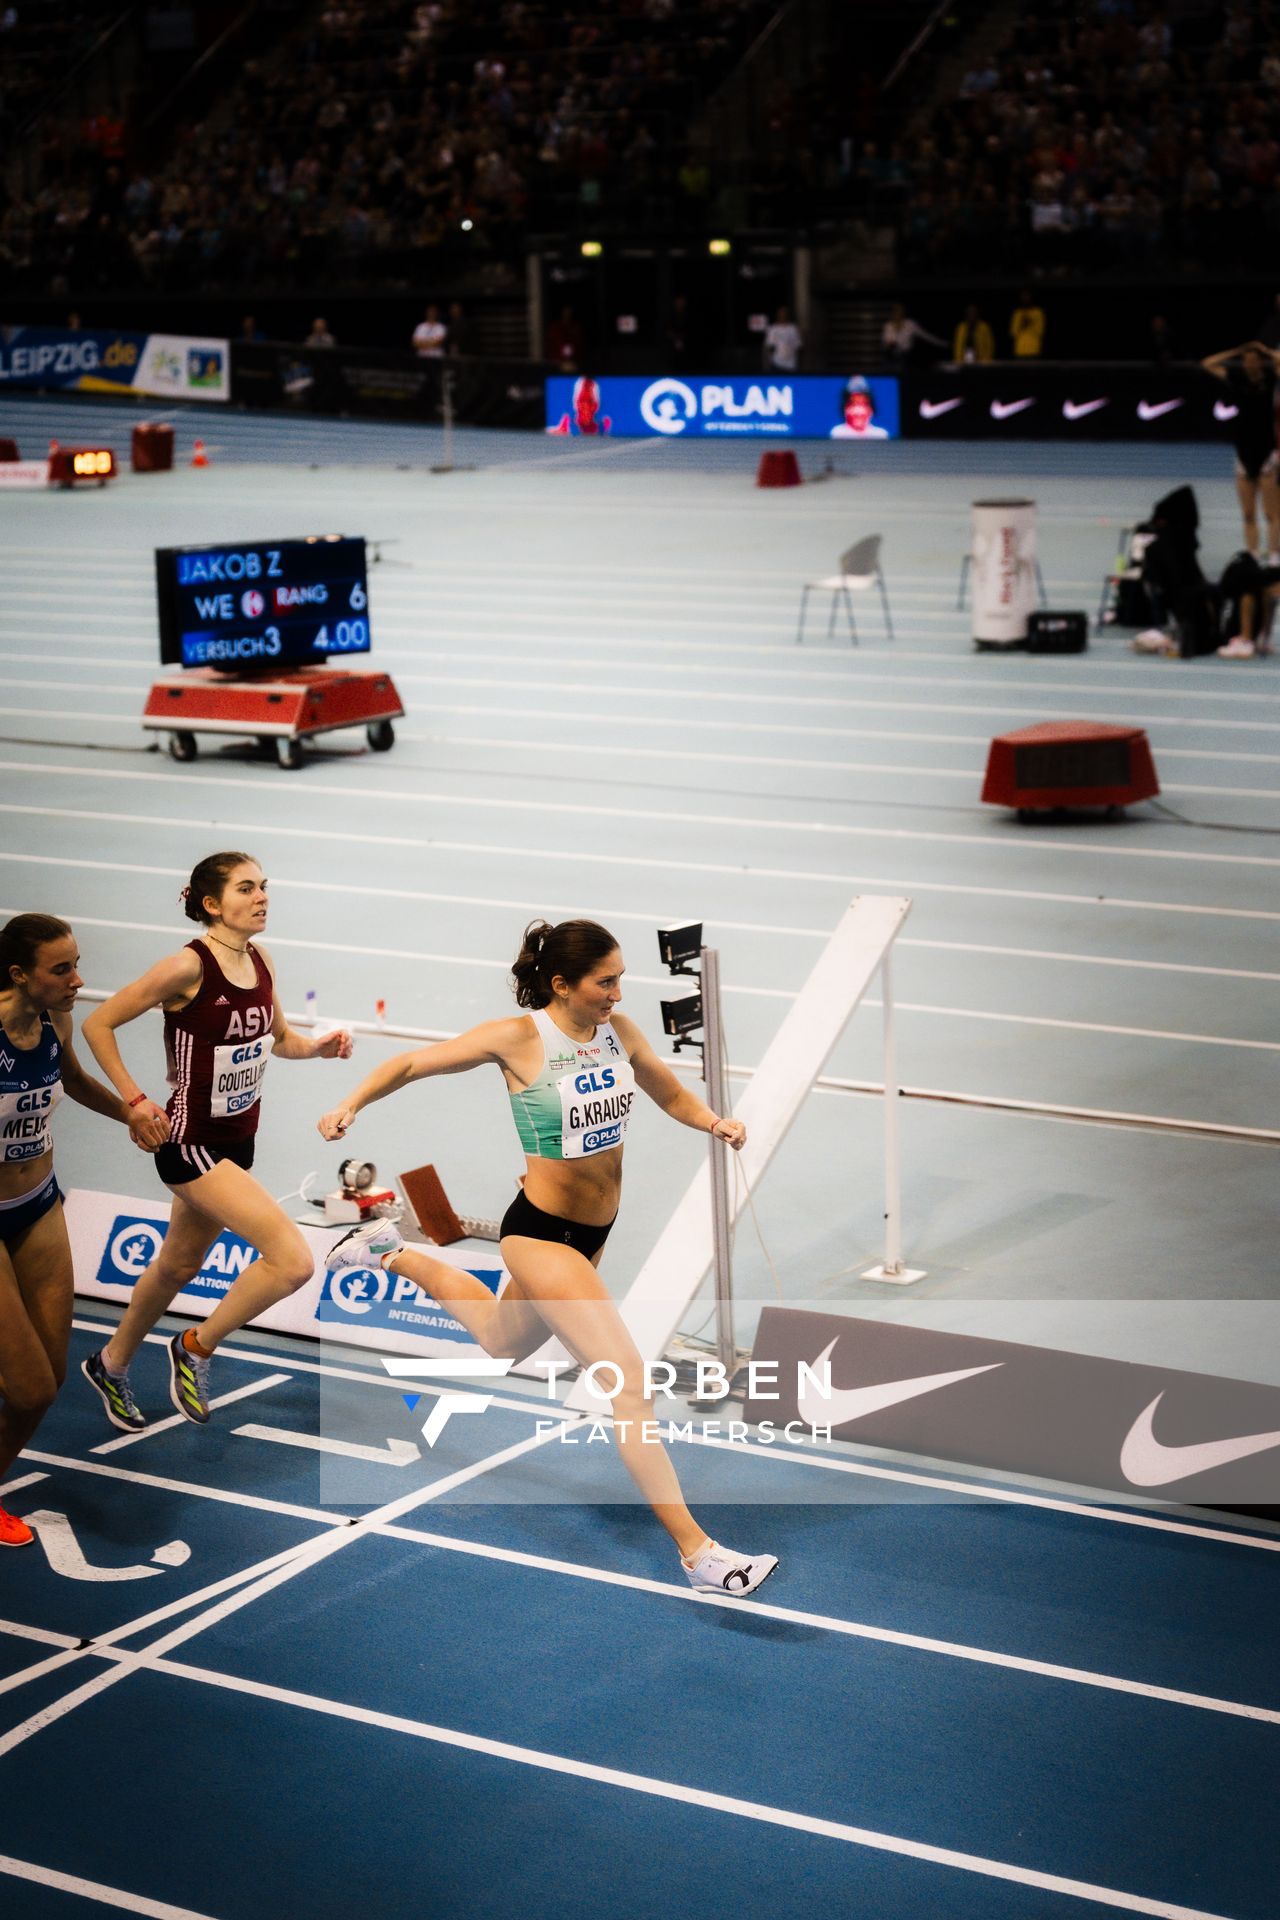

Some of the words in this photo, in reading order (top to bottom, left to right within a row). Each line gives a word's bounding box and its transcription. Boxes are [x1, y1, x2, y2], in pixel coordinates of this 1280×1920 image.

[702, 385, 793, 416] PLAN
[180, 553, 262, 581] JAKOB
[267, 550, 283, 577] Z
[194, 594, 234, 620] WE
[276, 584, 329, 606] RANG
[349, 582, 367, 610] 6
[313, 621, 366, 649] 4.00
[224, 1005, 274, 1040] ASV
[231, 1042, 262, 1065] GLS
[218, 1060, 267, 1093] COUTELL
[575, 1068, 616, 1095] GLS
[16, 1089, 51, 1113] GLS
[570, 1091, 635, 1129] G.KRAUSE
[202, 1242, 254, 1275] AN
[388, 1309, 467, 1332] INTERNATION
